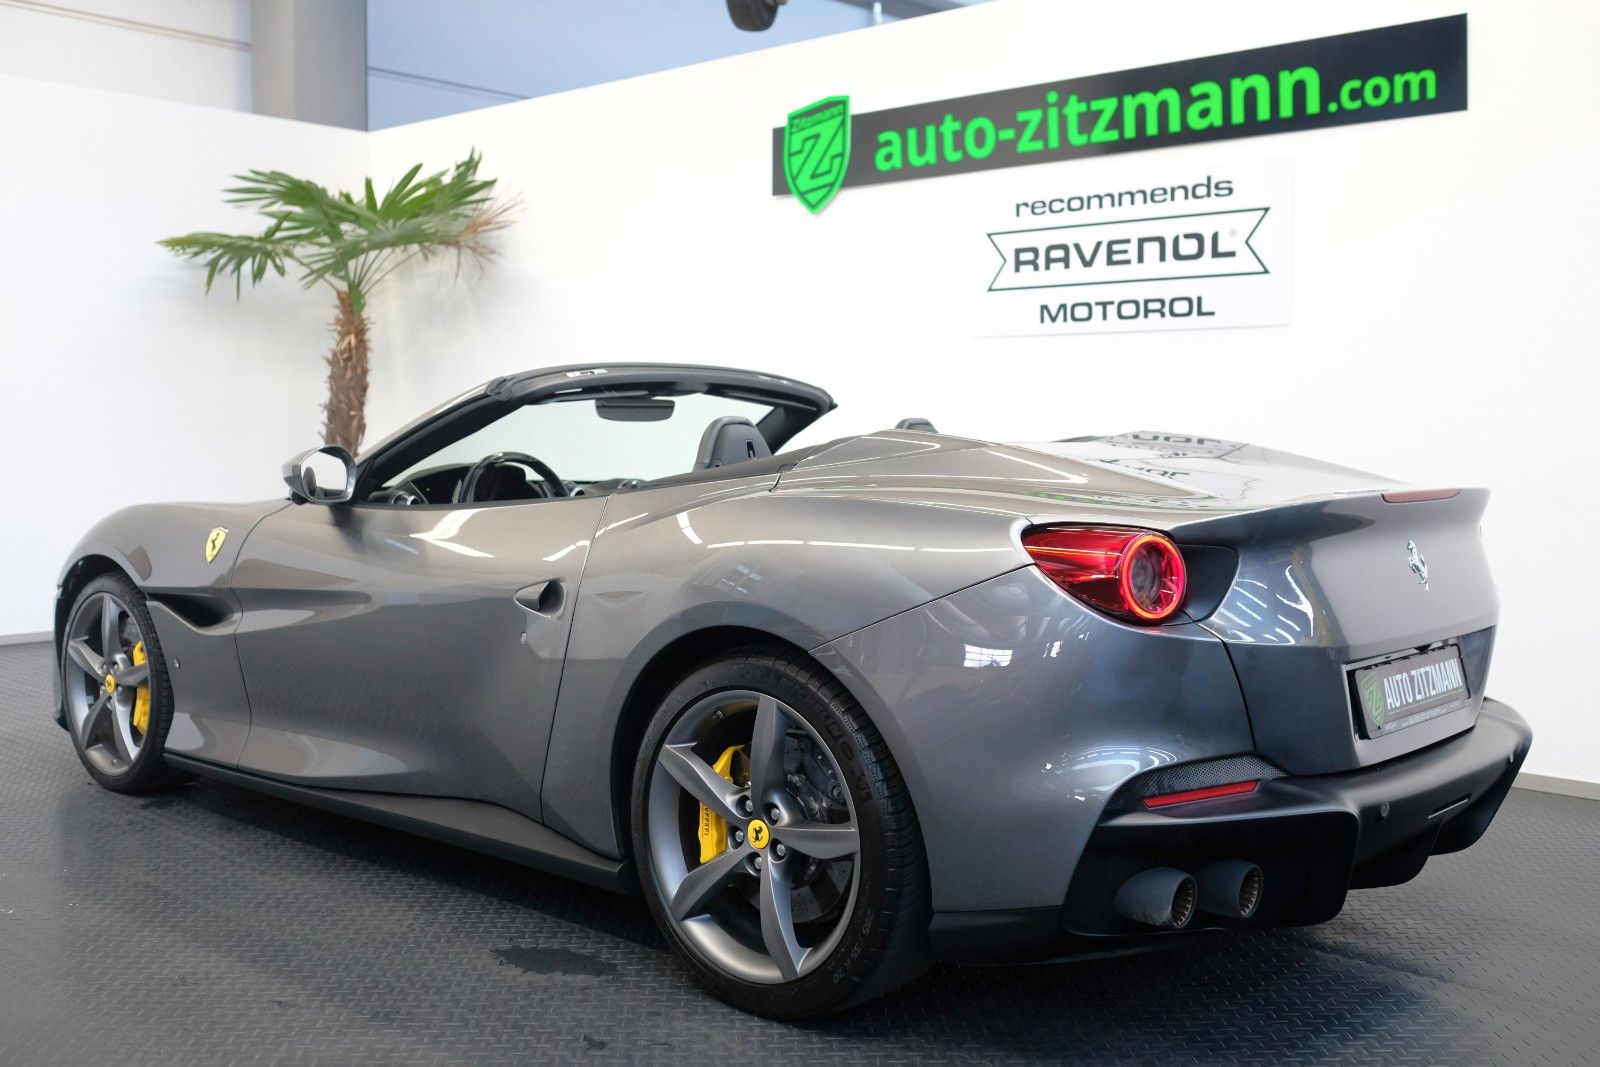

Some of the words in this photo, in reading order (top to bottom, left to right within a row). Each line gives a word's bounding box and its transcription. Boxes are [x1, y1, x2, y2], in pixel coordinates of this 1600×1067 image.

[874, 65, 1437, 172] auto-zitzmann.com
[1015, 175, 1234, 217] recommends
[1013, 230, 1237, 273] RAVENOL
[1040, 296, 1216, 324] MOTOROL
[1384, 672, 1413, 710] AUTO
[1411, 658, 1463, 701] ZITZMANN
